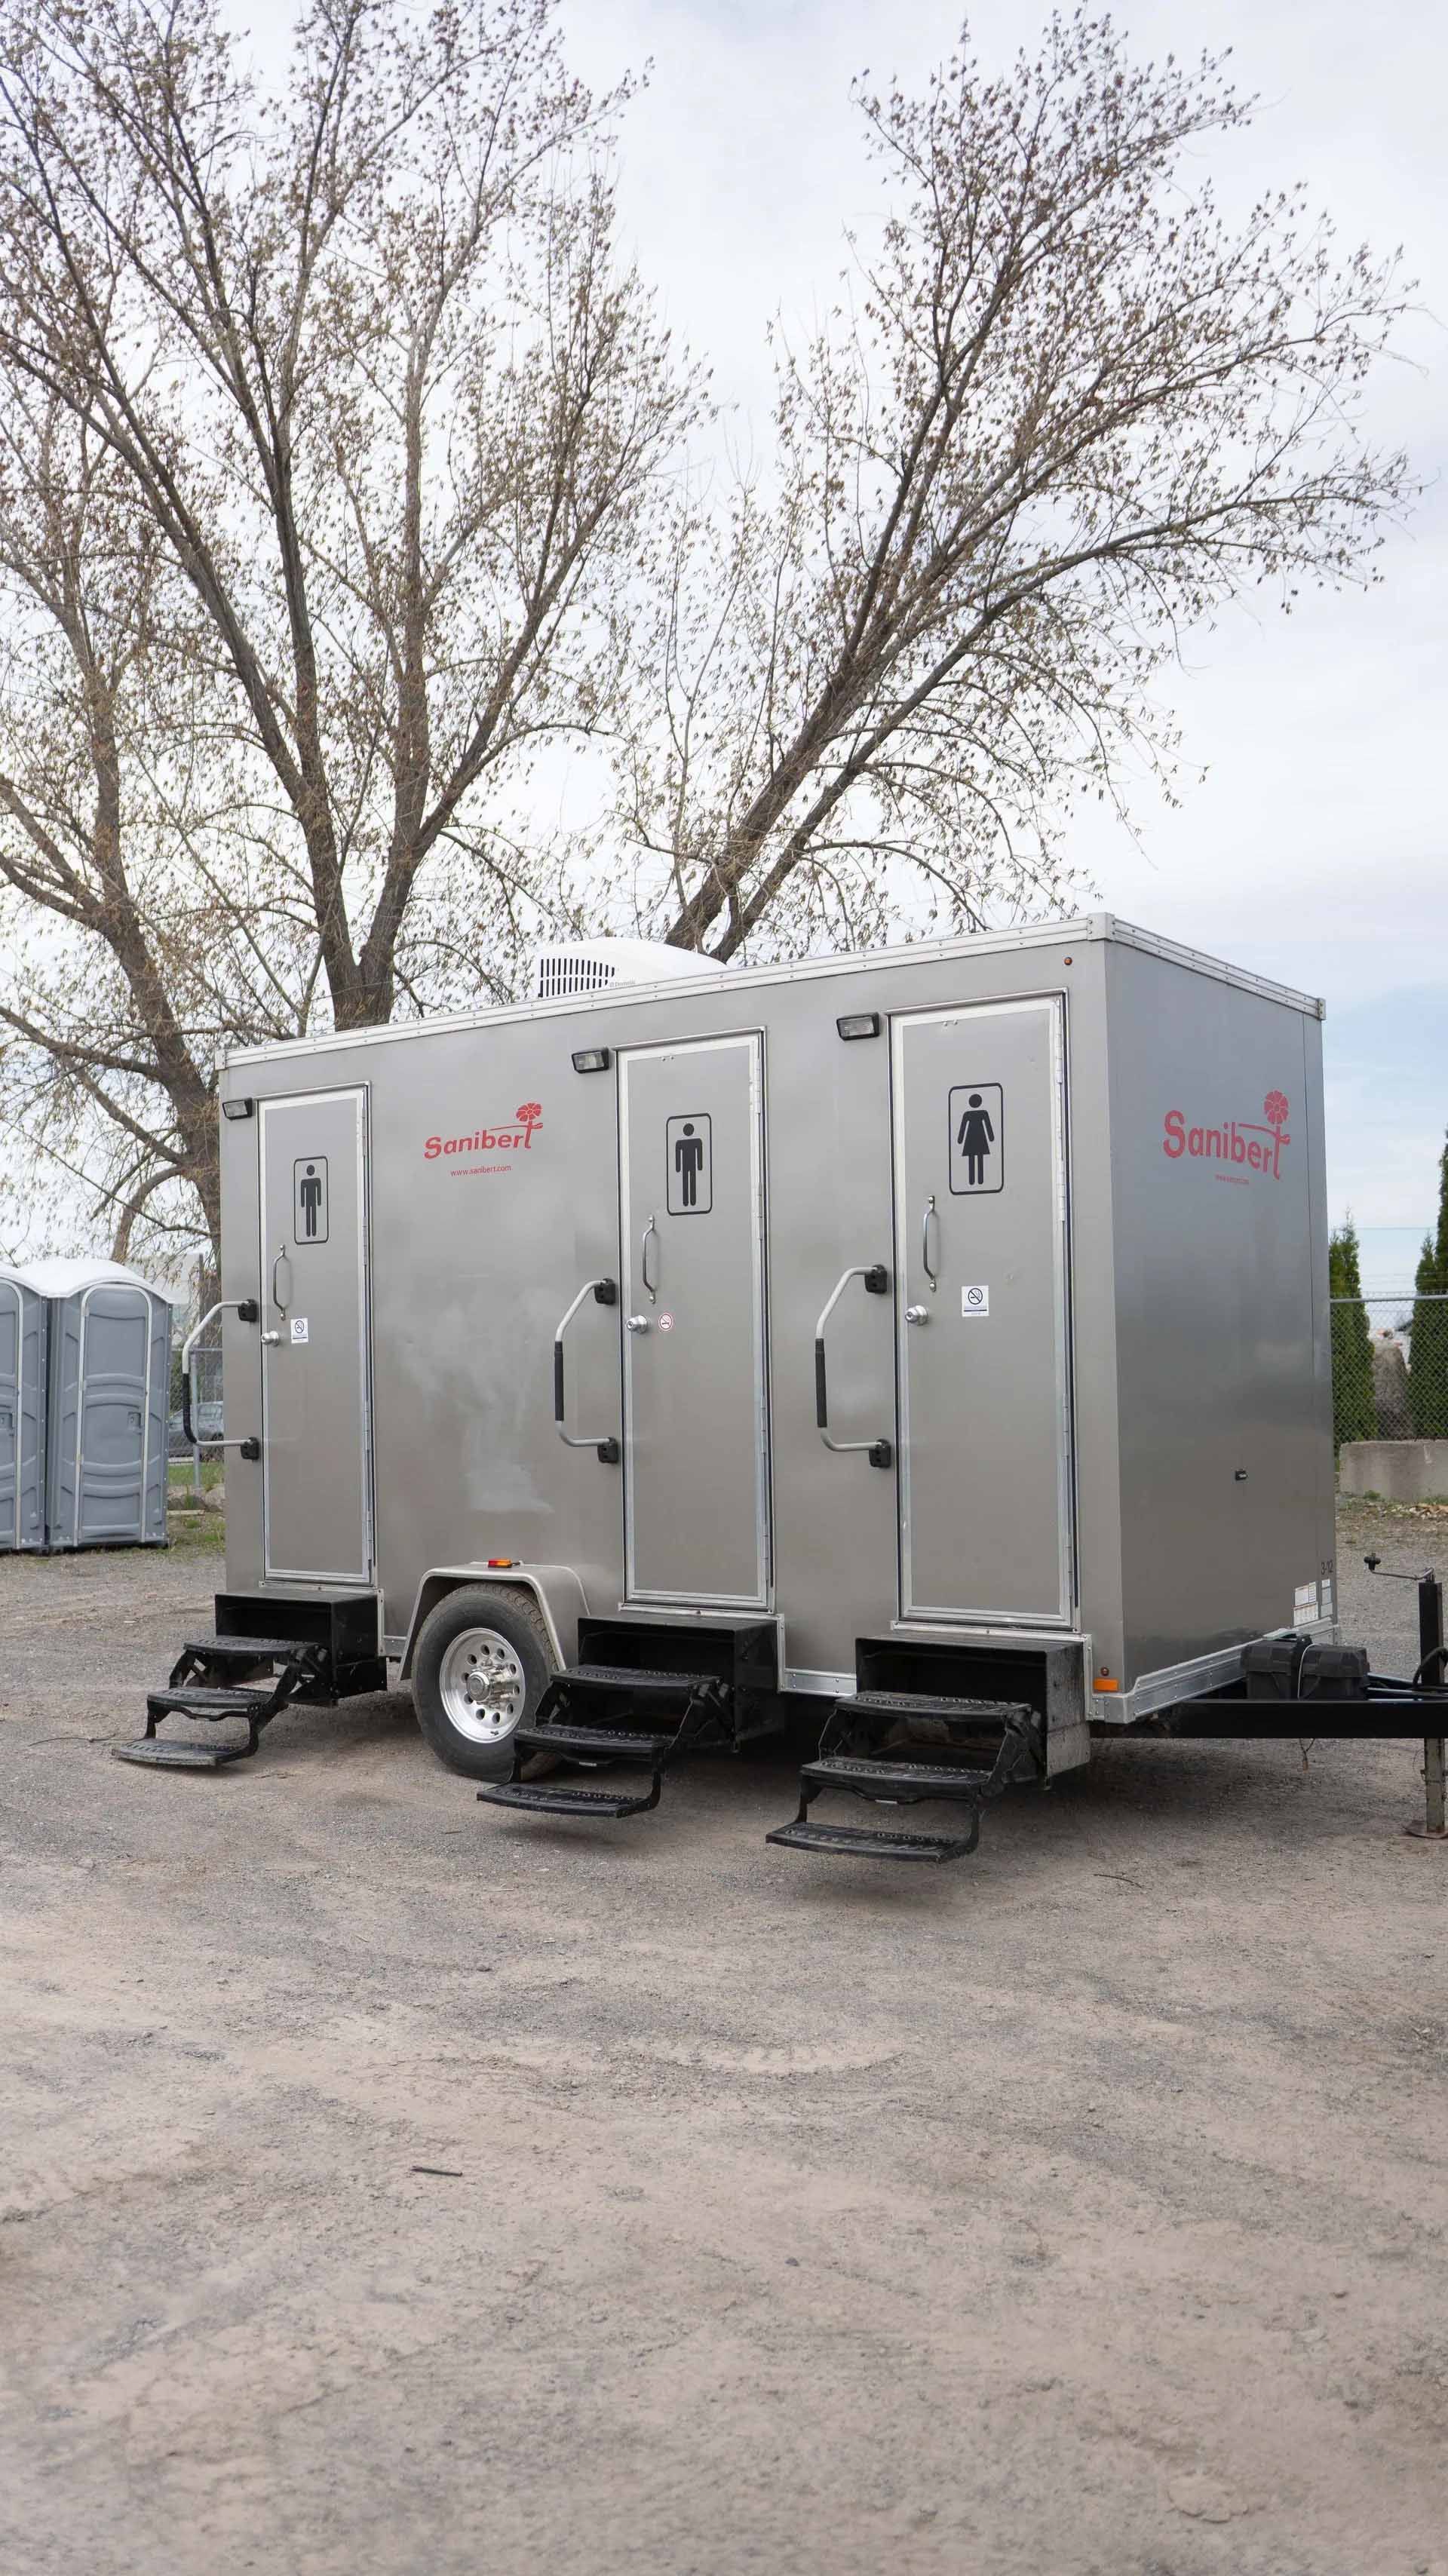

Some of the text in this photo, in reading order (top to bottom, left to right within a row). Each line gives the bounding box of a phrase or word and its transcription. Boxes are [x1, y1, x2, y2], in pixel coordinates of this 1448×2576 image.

[425, 1121, 542, 1159] Sanibert
[1164, 1110, 1290, 1180] Sanibert
[450, 1165, 511, 1176] www.sanibert.com
